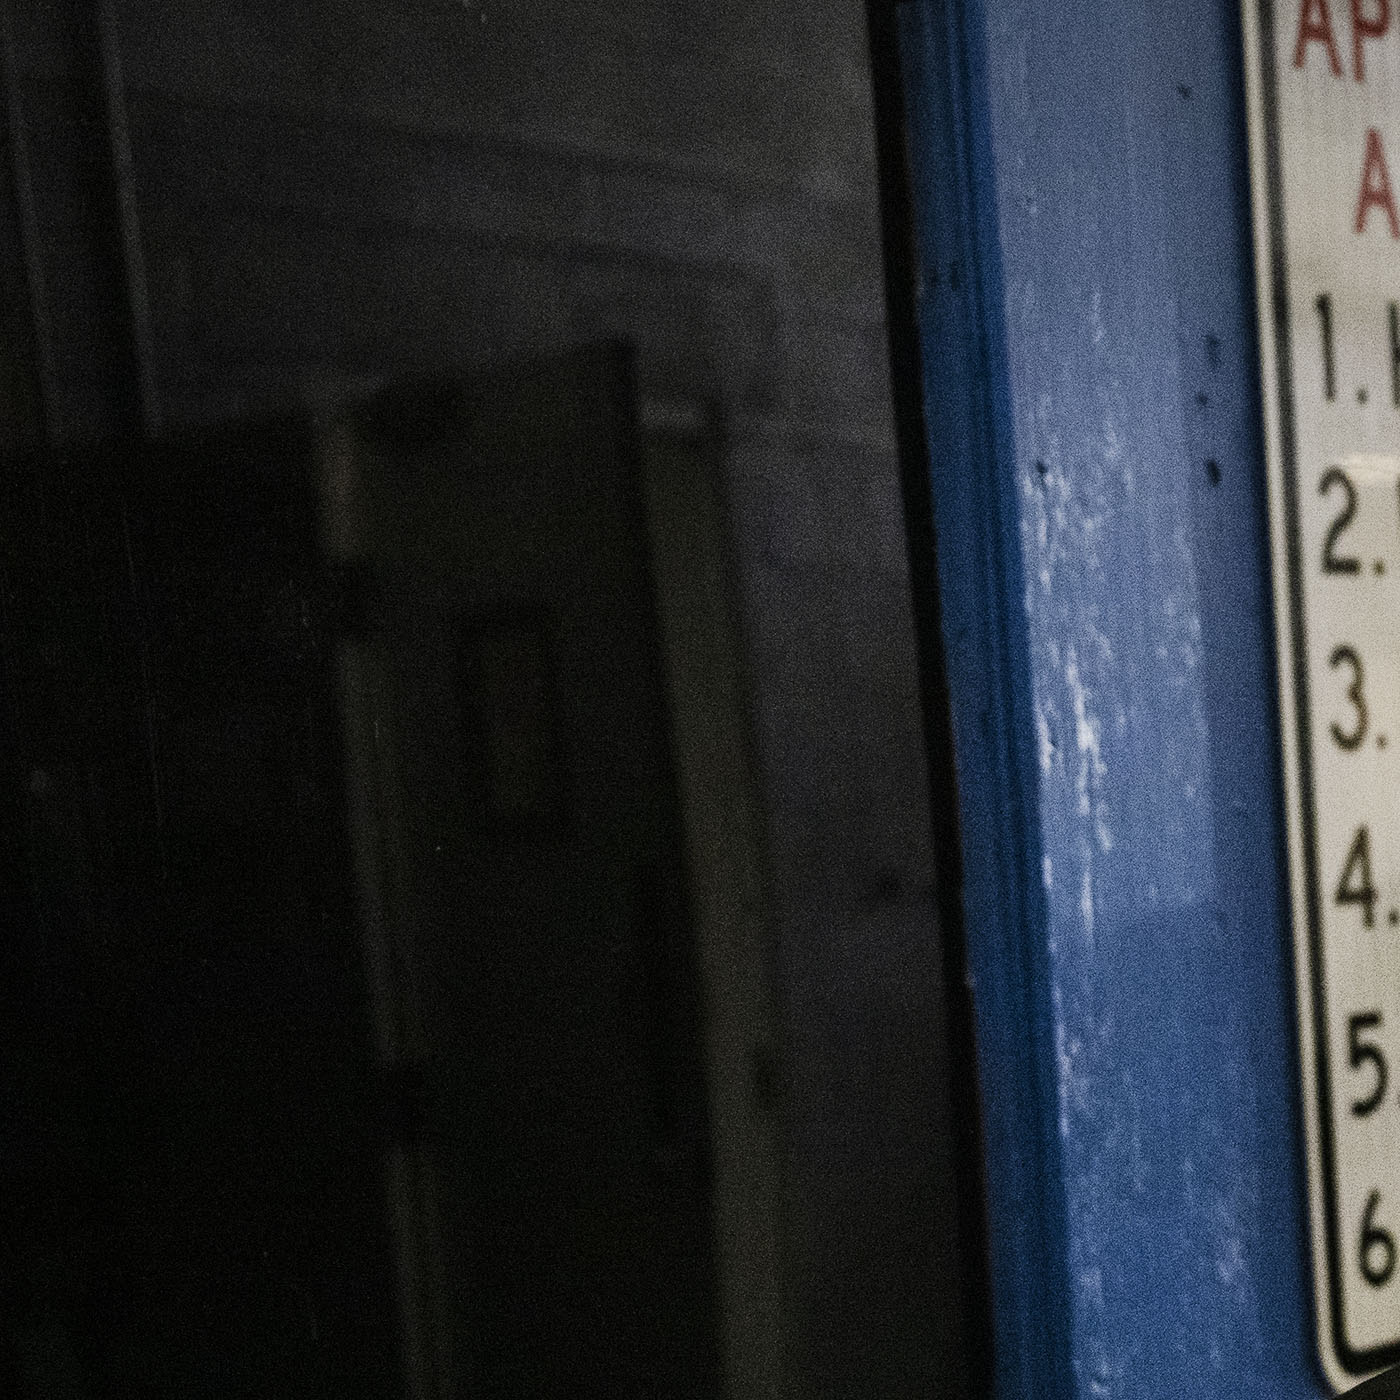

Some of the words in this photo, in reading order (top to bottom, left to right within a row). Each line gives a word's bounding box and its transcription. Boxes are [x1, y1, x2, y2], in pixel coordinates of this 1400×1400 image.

[1314, 294, 1369, 406] 1.
[1317, 465, 1387, 577] 2.
[1328, 643, 1388, 753] 3.
[1335, 822, 1400, 930] 4.
